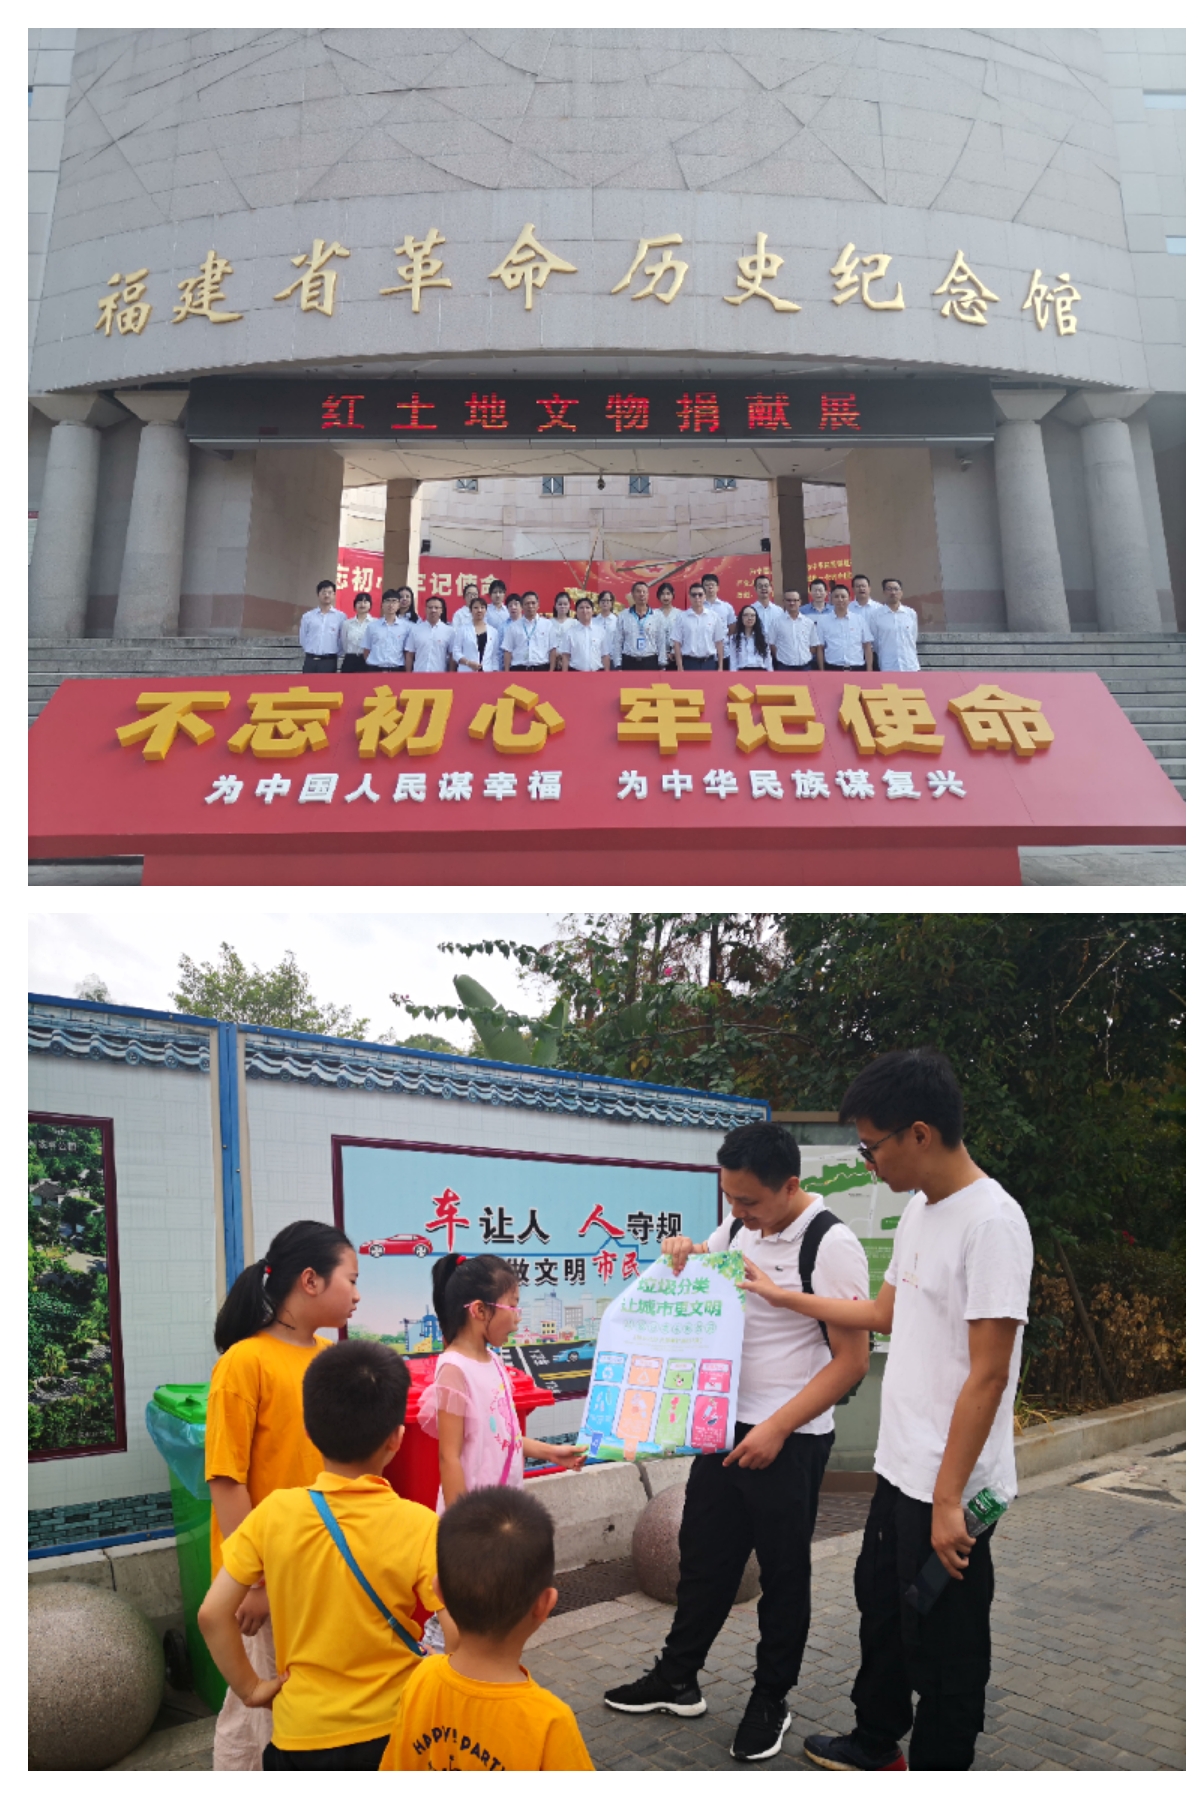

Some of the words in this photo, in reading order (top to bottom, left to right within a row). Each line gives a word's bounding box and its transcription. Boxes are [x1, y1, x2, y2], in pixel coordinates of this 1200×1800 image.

[96, 223, 1082, 337] 福建省革命历史纪念馆
[321, 392, 862, 432] 红土地文物捐献展
[115, 684, 566, 762] 不忘初心
[617, 683, 1056, 757] 牢记使命
[204, 770, 564, 805] 为中国人民谋幸福
[617, 769, 967, 800] 为中华民族谋复兴
[637, 1276, 711, 1296] 垃圾分类
[621, 1298, 723, 1318] 让城市更文明
[460, 1735, 506, 1771] PART
